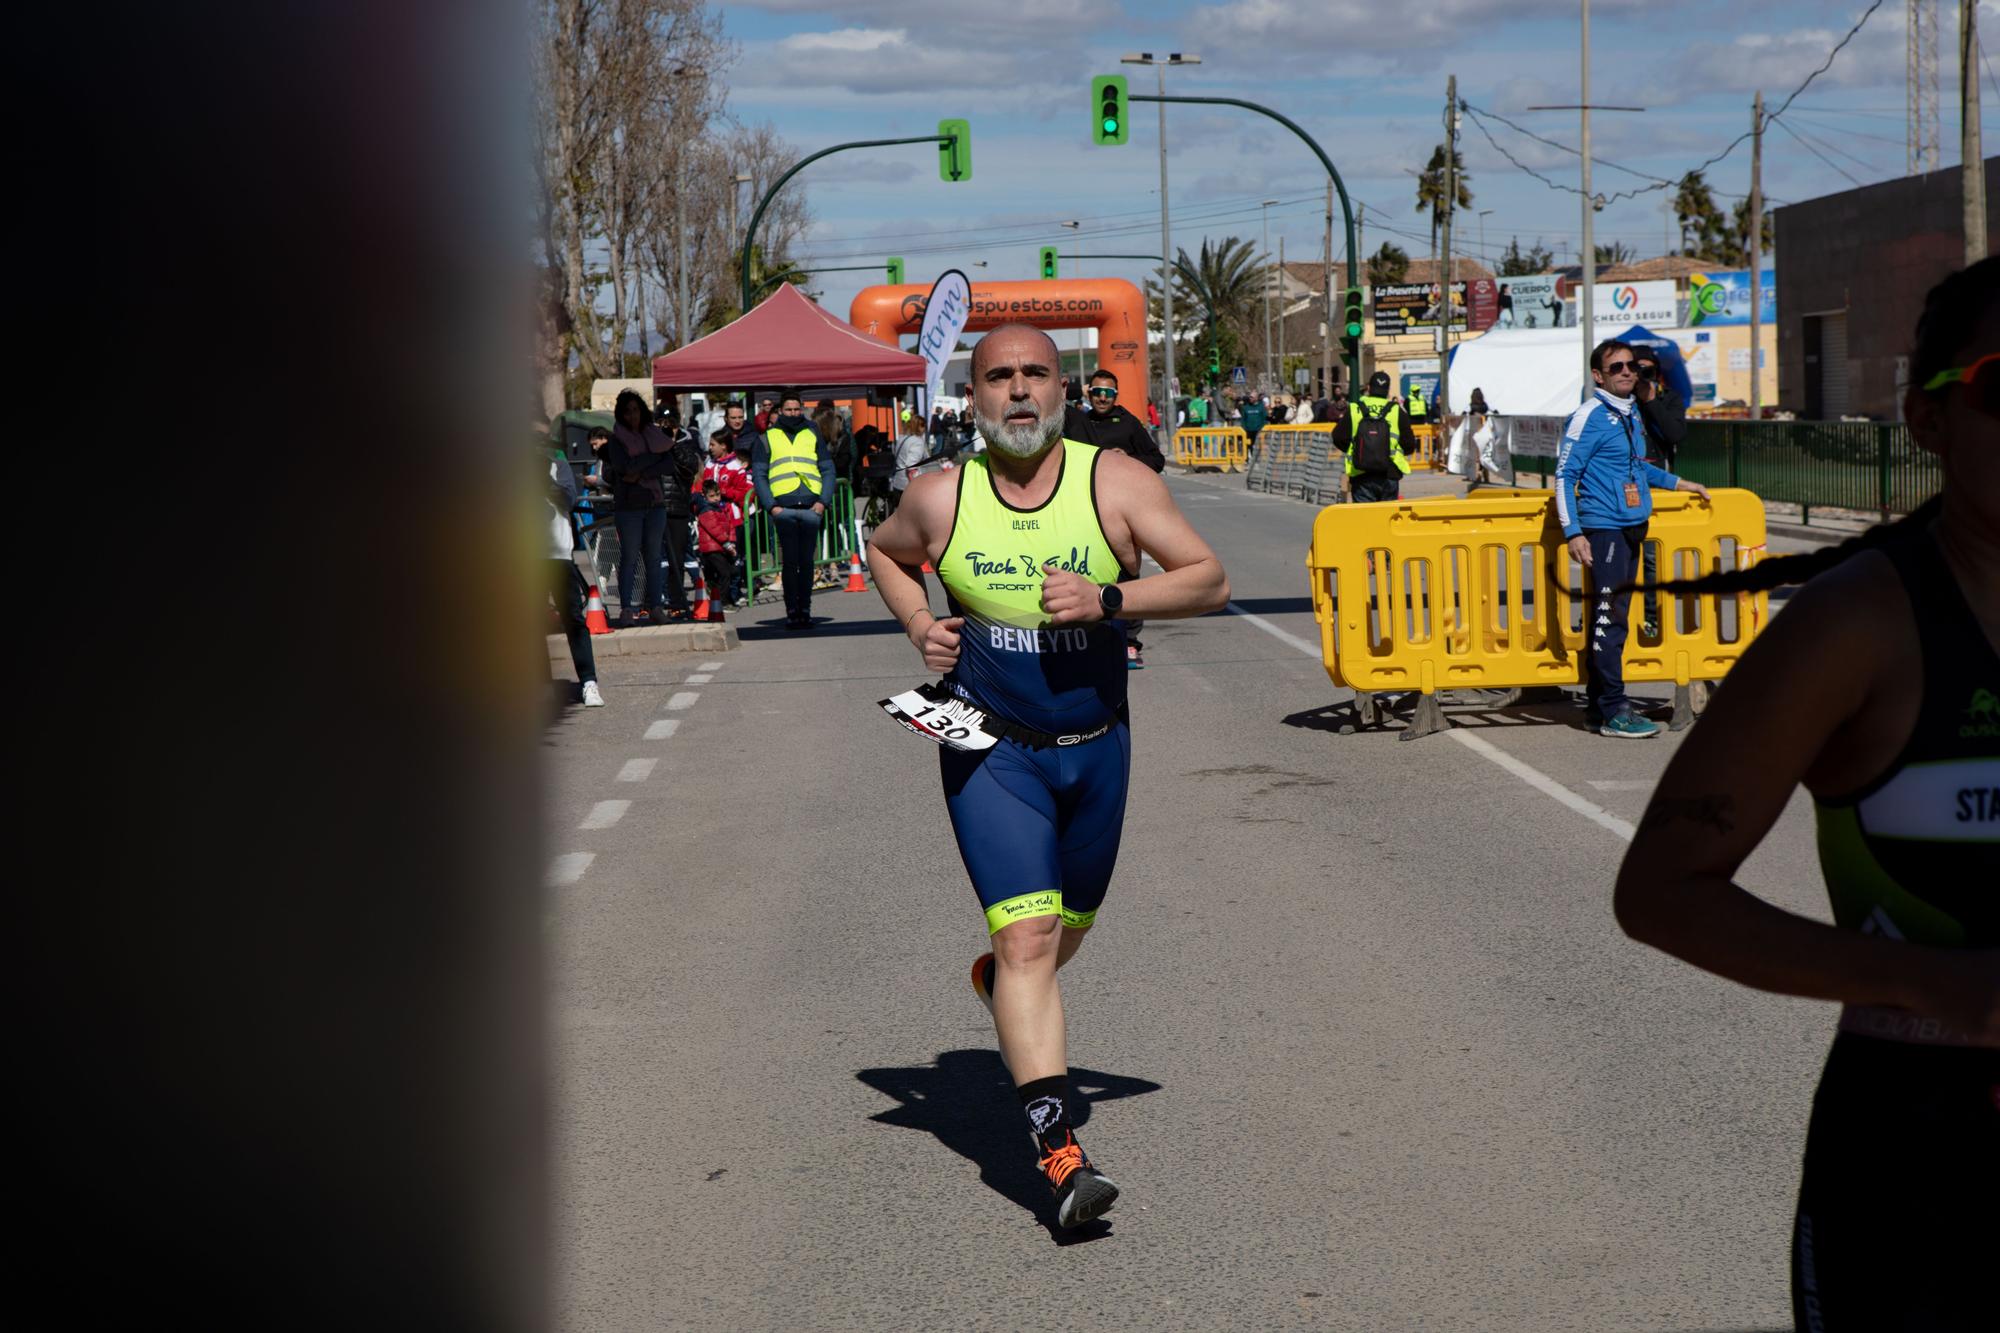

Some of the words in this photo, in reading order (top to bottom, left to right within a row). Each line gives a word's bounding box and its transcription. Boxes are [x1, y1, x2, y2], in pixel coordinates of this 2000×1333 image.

[1512, 285, 1551, 295] CUERPO
[1580, 313, 1631, 324] PCHECO
[965, 552, 1018, 577] Track
[1019, 555, 1043, 578] &
[987, 583, 1034, 591] SPORT
[990, 625, 1088, 653] BENEYTO
[914, 706, 970, 739] 130
